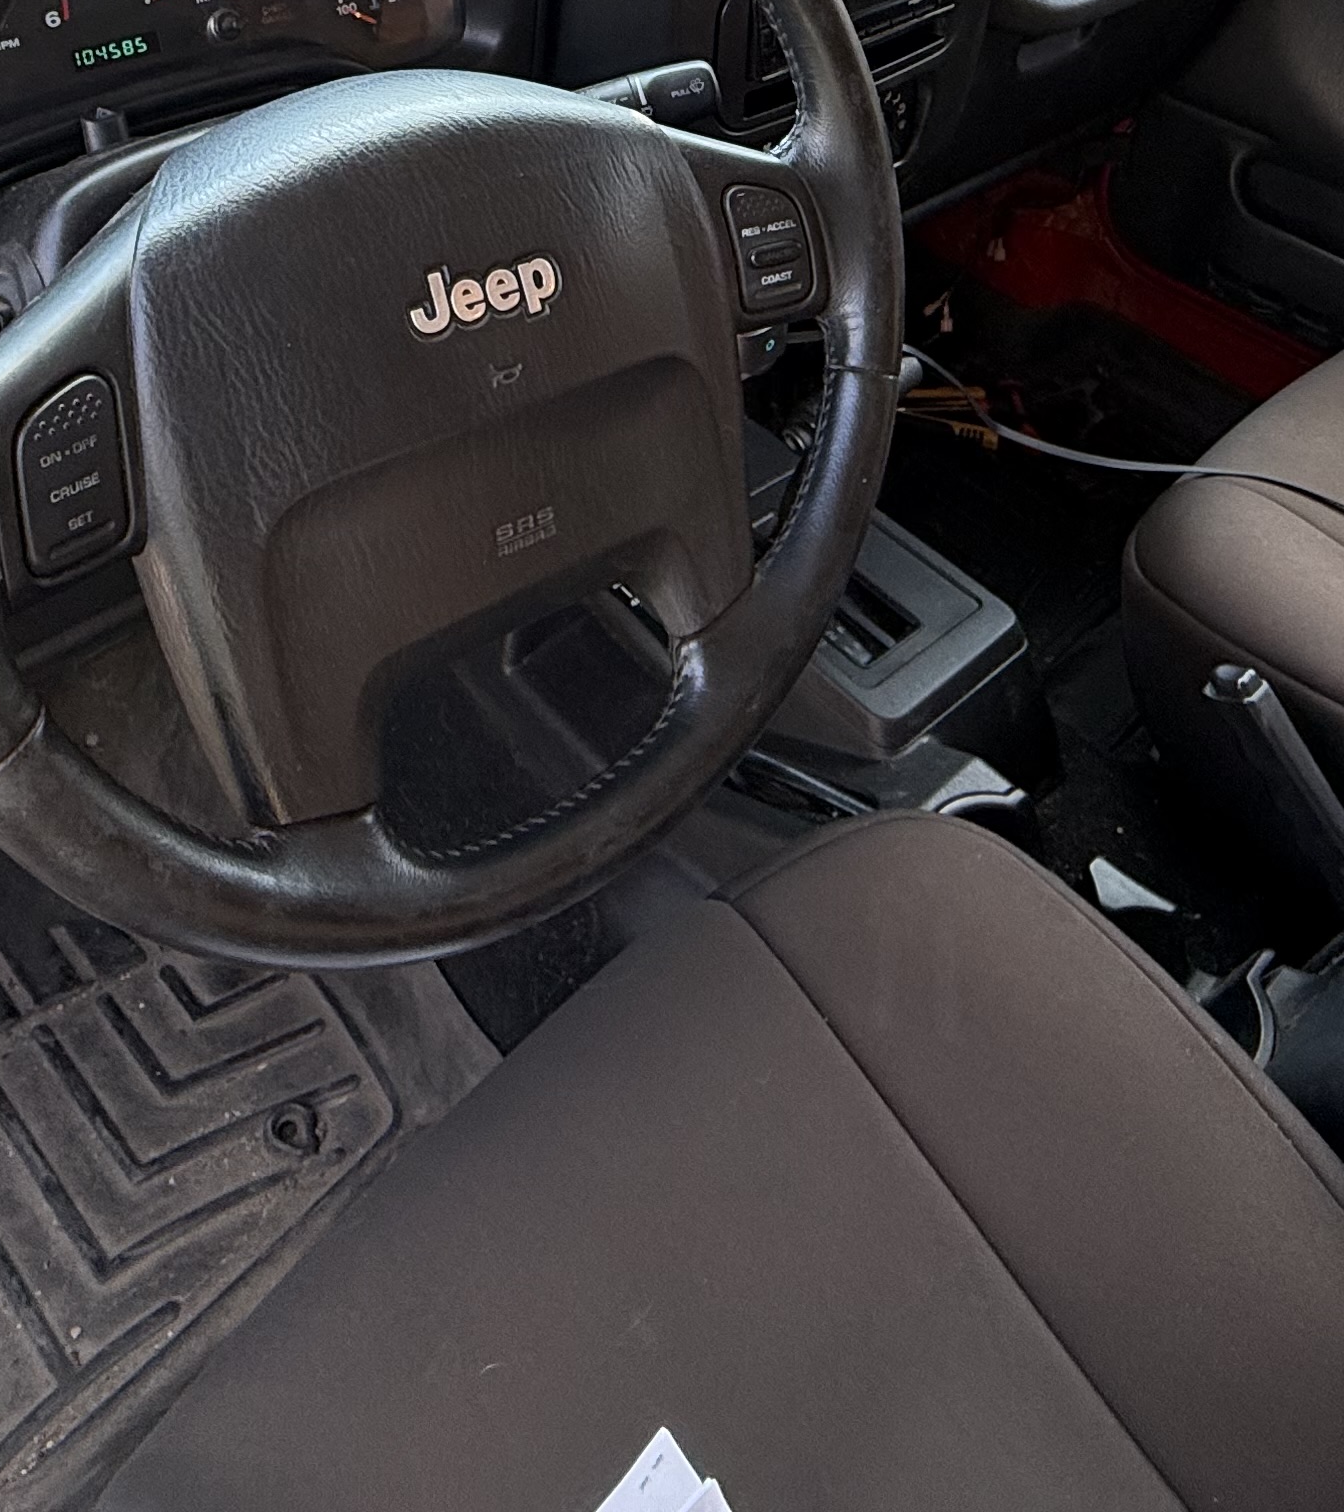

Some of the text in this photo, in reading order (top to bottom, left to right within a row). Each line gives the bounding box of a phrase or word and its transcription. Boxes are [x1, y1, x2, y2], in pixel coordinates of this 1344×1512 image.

[44, 10, 62, 29] 6
[335, 1, 358, 17] 100
[74, 36, 148, 67] 104585
[767, 219, 797, 233] ACCEL
[761, 270, 793, 286] COAST
[410, 257, 556, 334] Jeep
[40, 434, 98, 469] ON OFF
[49, 471, 101, 504] CRUISE
[67, 510, 95, 531] SET
[495, 505, 556, 542] SRS
